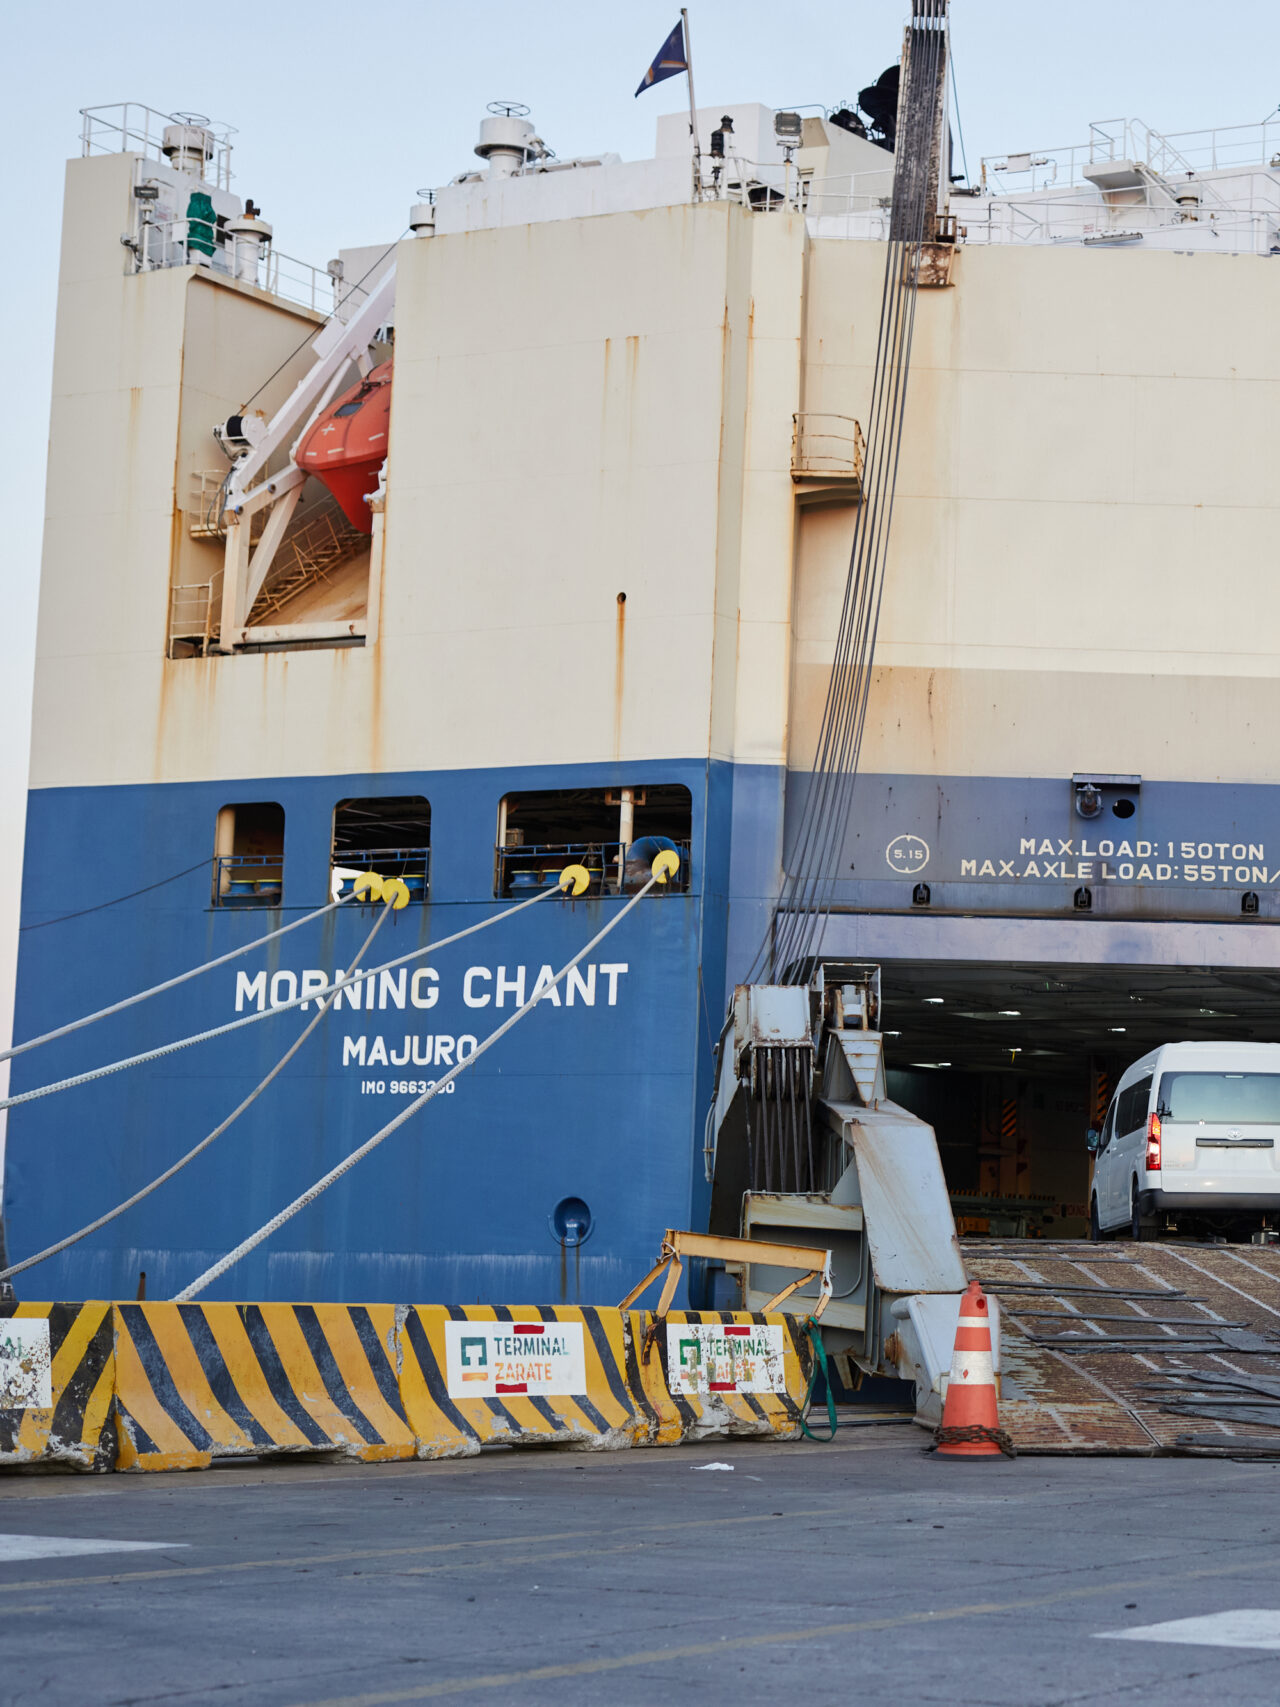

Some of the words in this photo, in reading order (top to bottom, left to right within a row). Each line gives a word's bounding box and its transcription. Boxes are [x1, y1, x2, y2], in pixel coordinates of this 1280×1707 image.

[894, 849, 923, 859] 5.15
[235, 967, 440, 1011] MORNING
[463, 963, 629, 1008] CHANT
[342, 1034, 478, 1066] MAJURO
[361, 1080, 386, 1094] IMO
[389, 1080, 455, 1094] 966330
[493, 1337, 570, 1356] TERMINAL
[707, 1338, 769, 1356] TERMINAL
[494, 1362, 553, 1381] ZARATE
